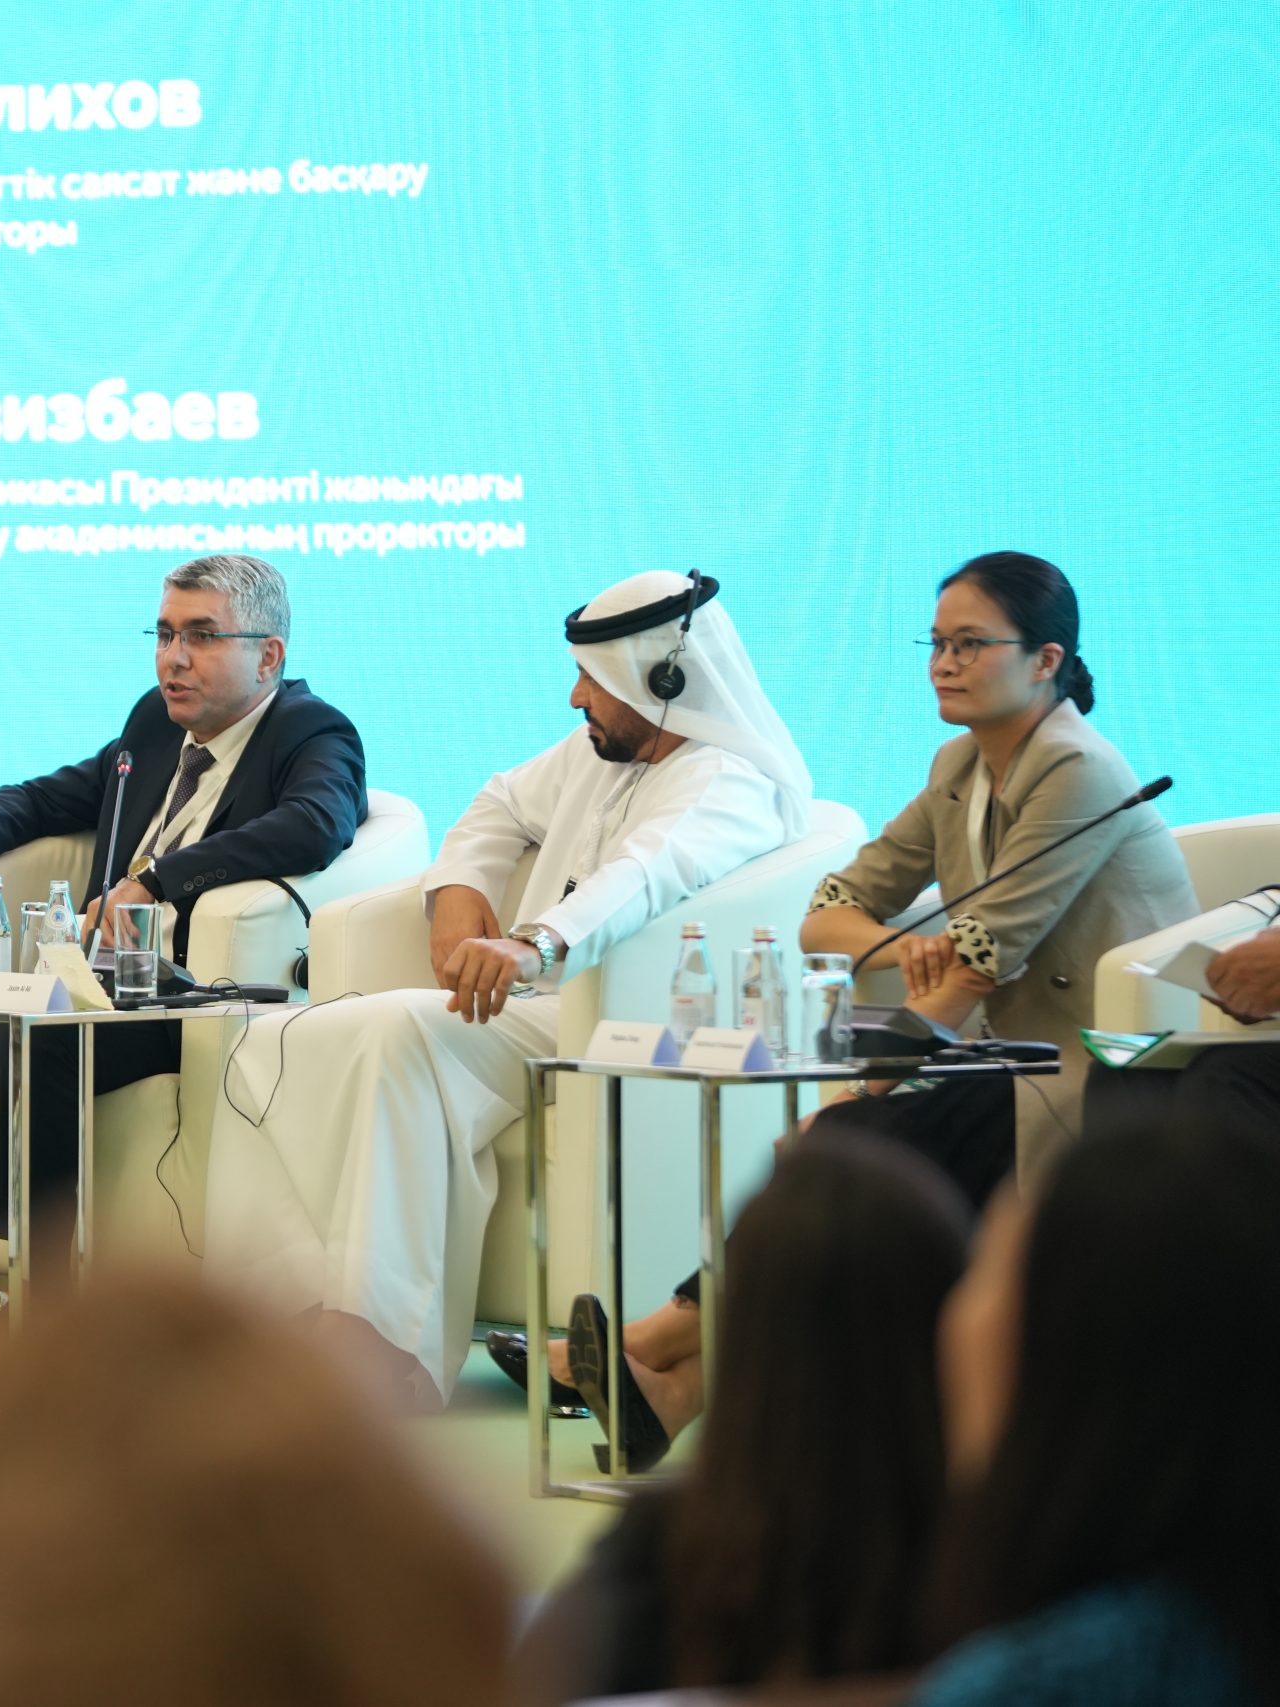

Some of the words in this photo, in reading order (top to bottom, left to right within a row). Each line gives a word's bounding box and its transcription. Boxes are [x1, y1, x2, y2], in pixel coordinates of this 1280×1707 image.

[61, 171, 180, 199] саясат
[187, 168, 281, 195] және
[289, 160, 428, 196] басқару
[111, 470, 319, 510] Президенті
[15, 524, 309, 557] академиясының
[314, 522, 524, 556] проректоры
